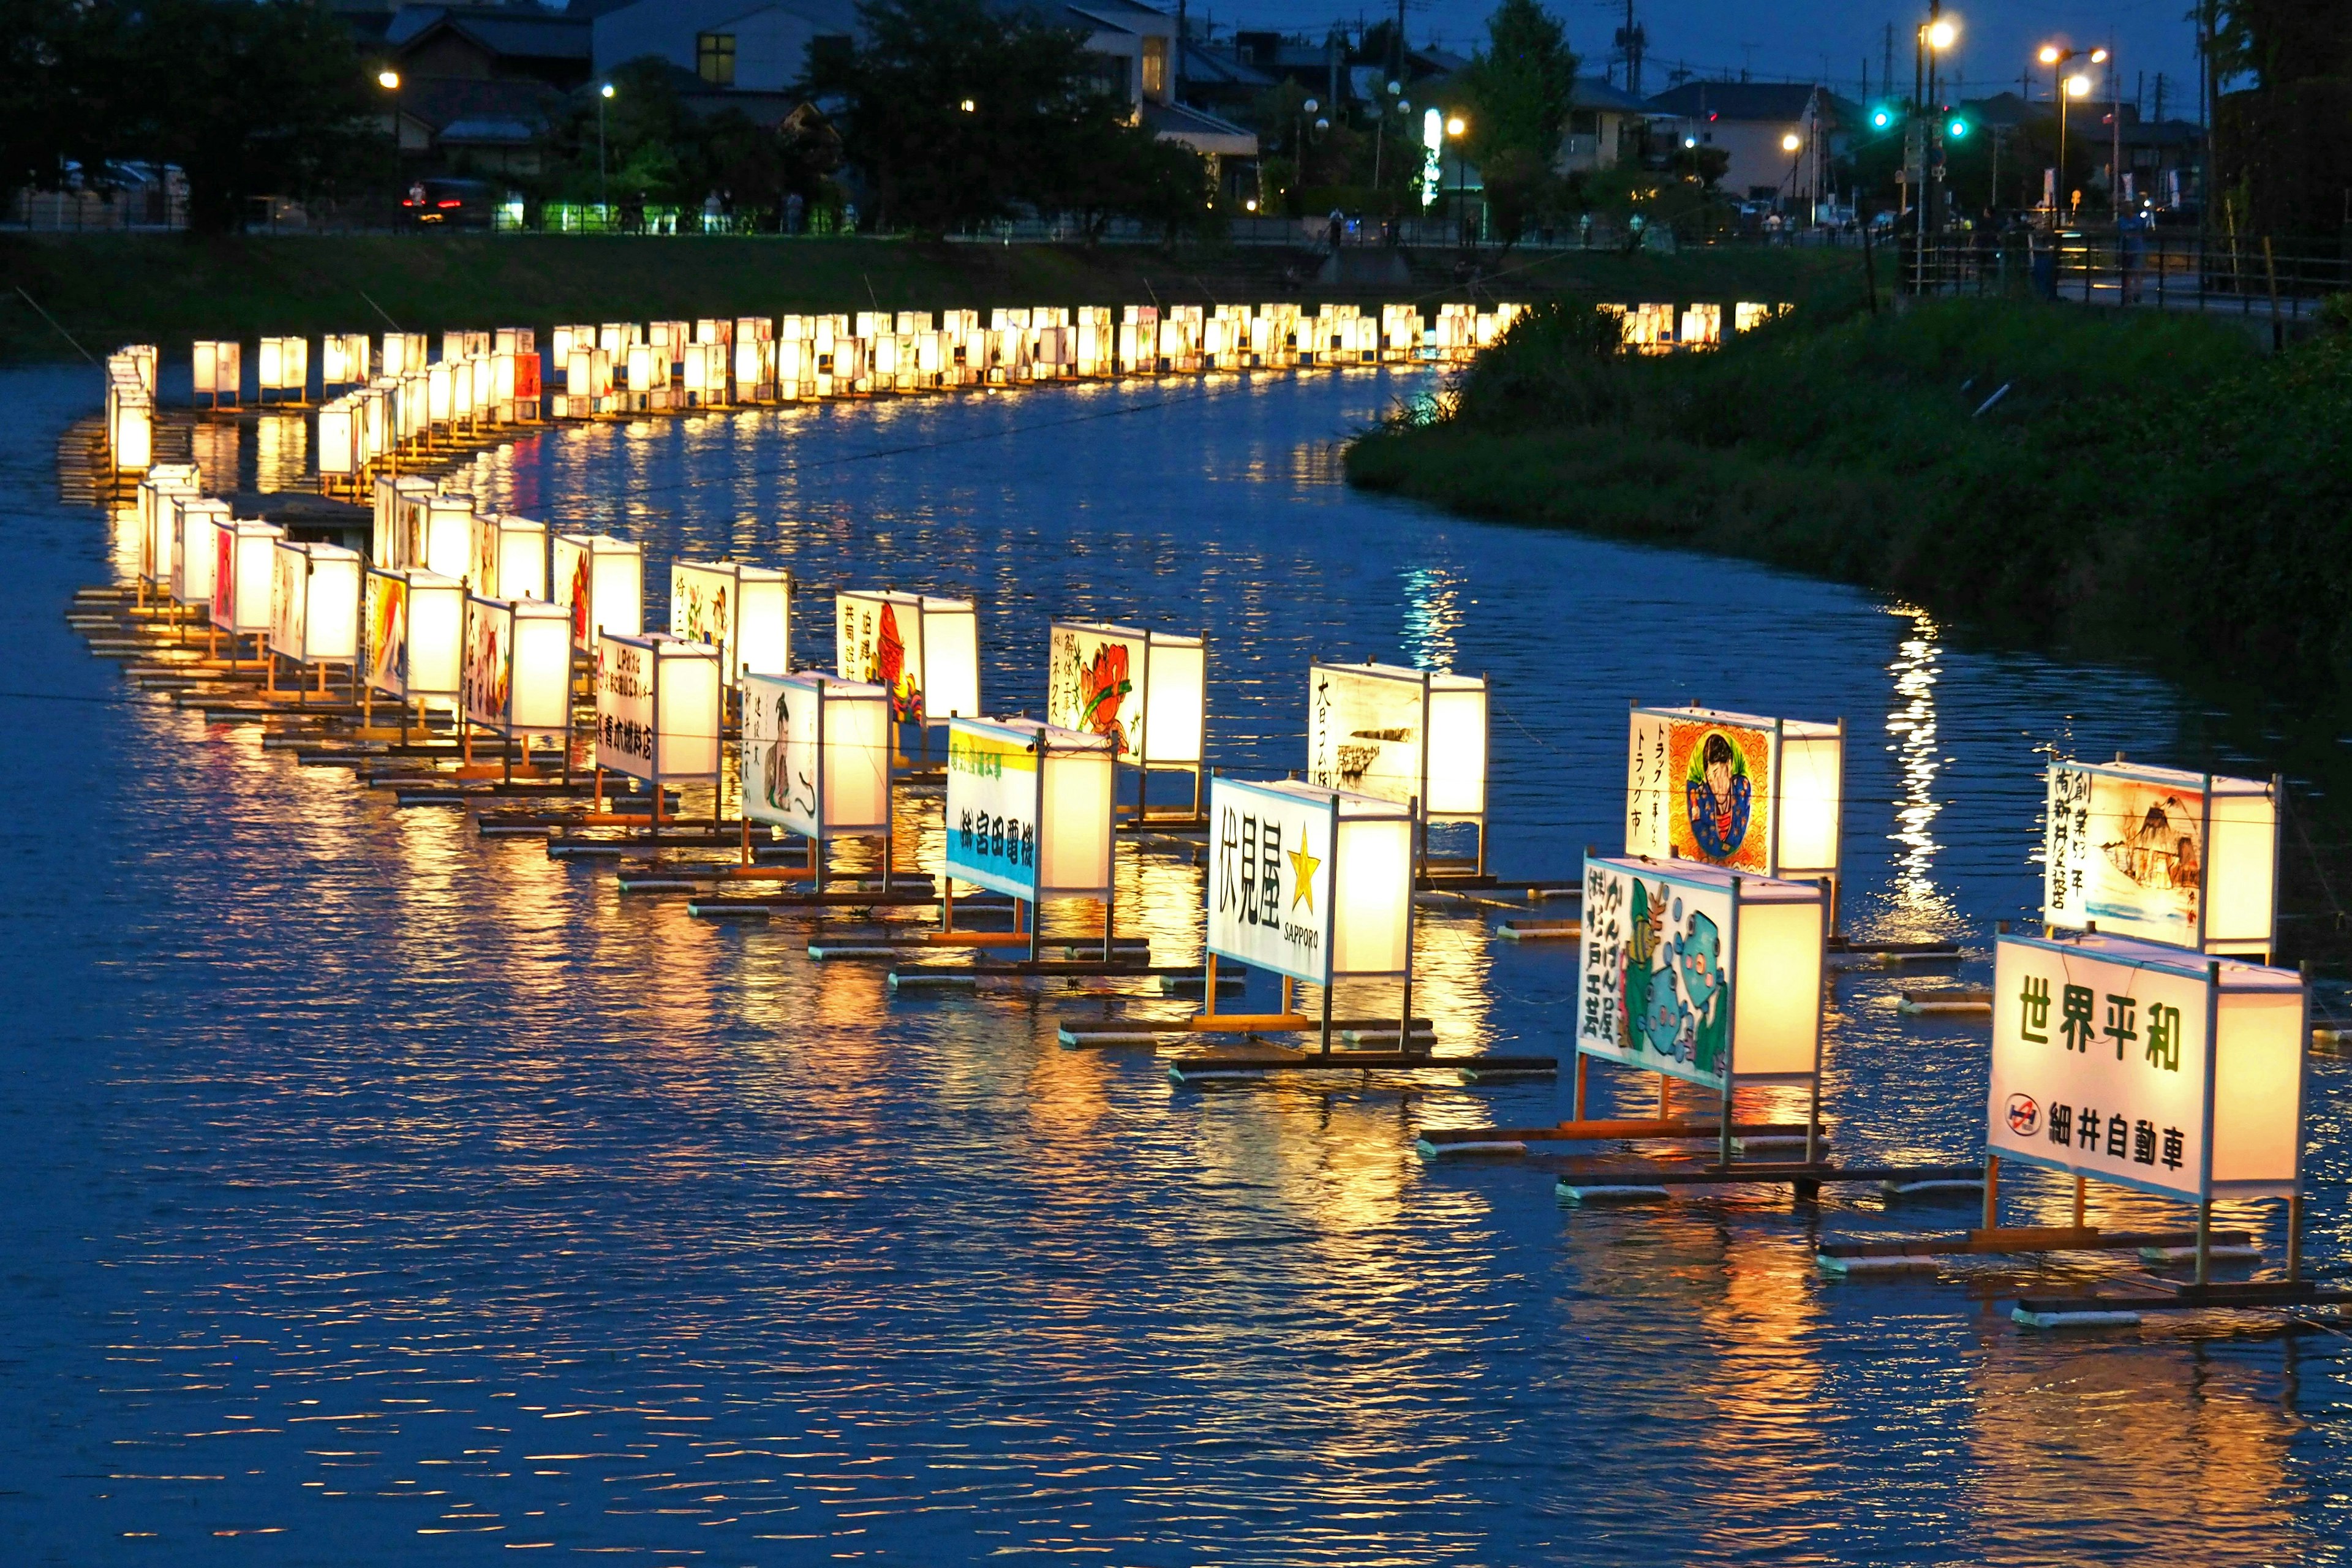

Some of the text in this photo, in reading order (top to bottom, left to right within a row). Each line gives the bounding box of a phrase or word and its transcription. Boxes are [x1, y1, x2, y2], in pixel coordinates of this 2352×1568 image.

[1062, 634, 1075, 729] 解体工事
[1631, 728, 1646, 837] トラック市
[1652, 723, 1665, 847] トラックの事なら
[1218, 803, 1281, 930] 伏見屋
[1284, 922, 1318, 949] SAPPORO
[2020, 975, 2180, 1072] 世界平和
[2048, 1101, 2184, 1171] 細井自動車
